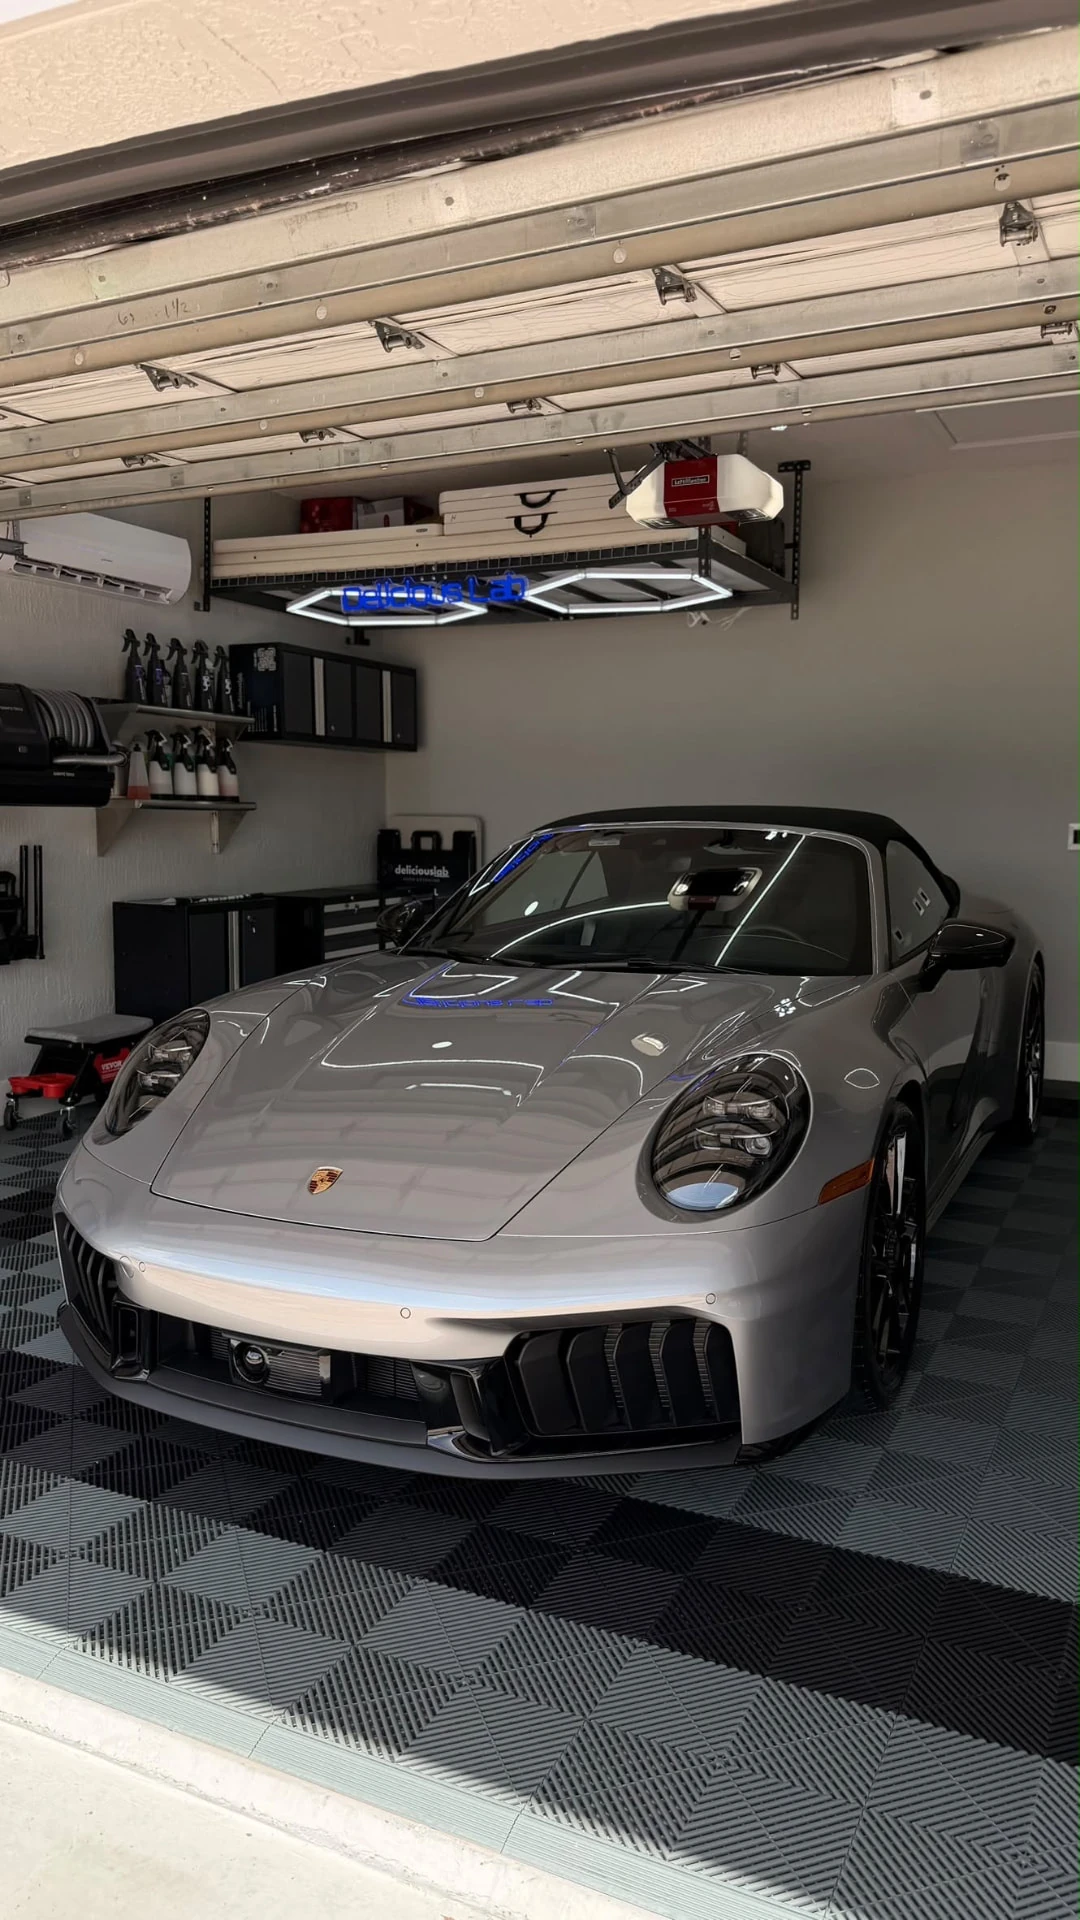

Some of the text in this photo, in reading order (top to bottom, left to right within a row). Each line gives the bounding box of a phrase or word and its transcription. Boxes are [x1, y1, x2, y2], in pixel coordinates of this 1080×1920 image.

[342, 573, 528, 612] Delicious Lab
[394, 864, 450, 878] deliciouslab
